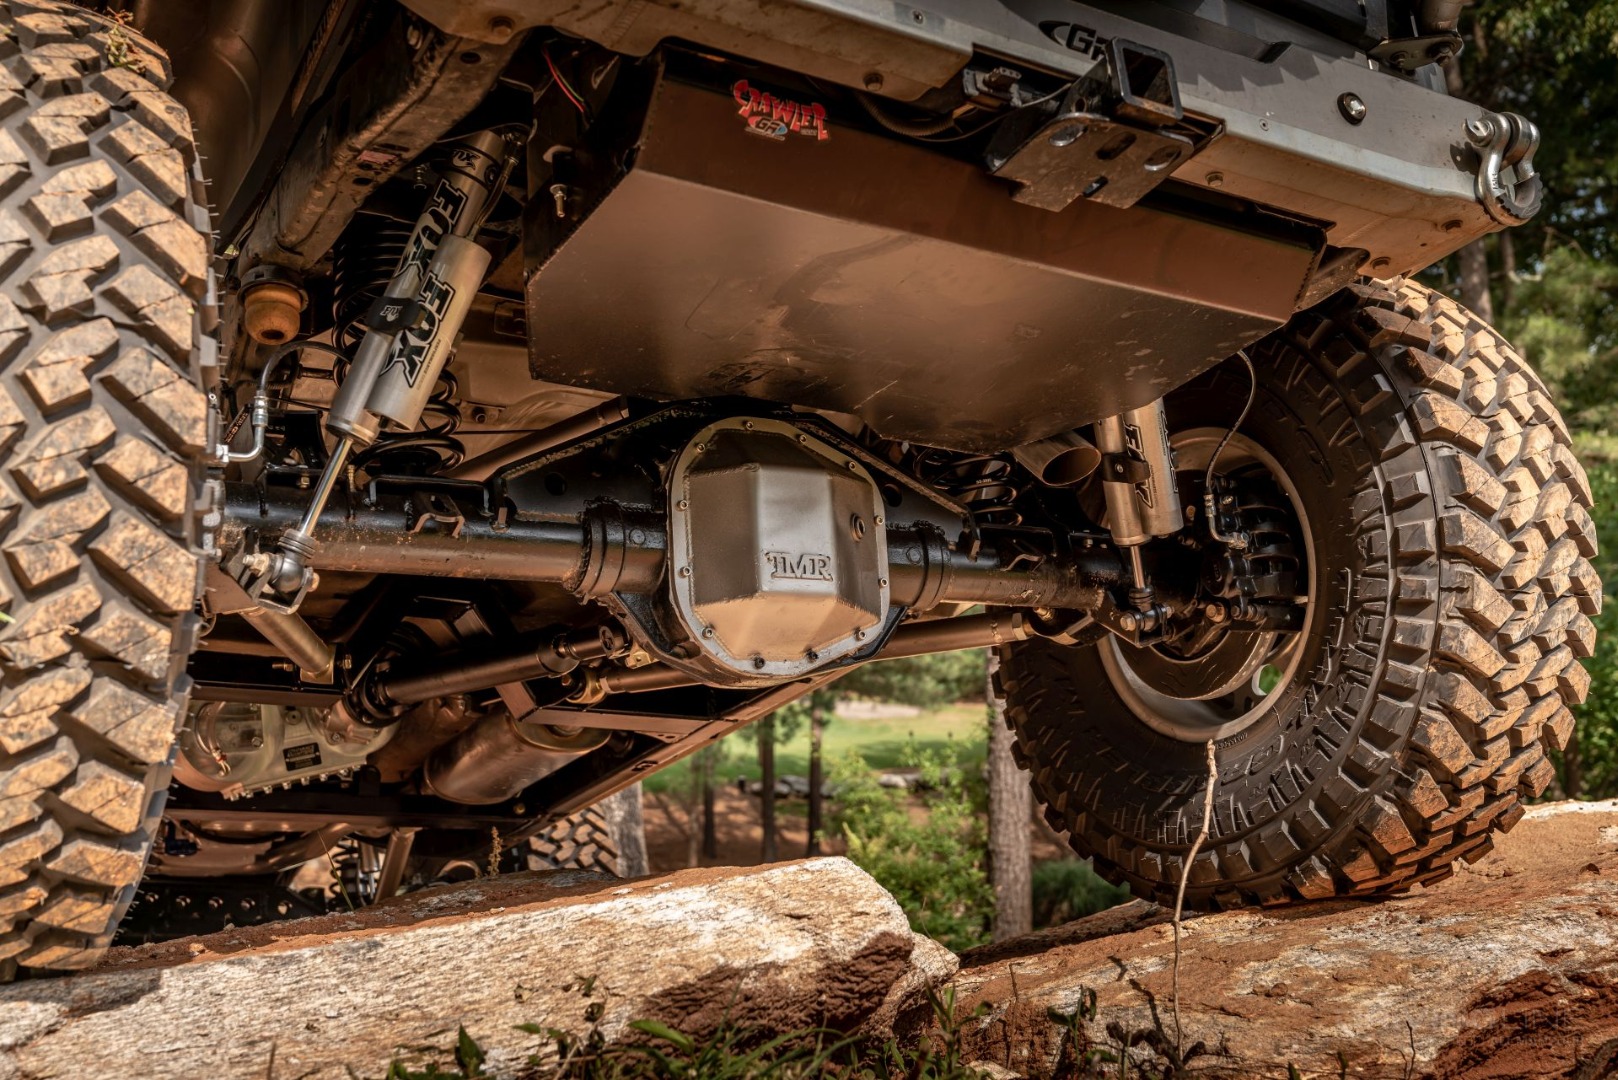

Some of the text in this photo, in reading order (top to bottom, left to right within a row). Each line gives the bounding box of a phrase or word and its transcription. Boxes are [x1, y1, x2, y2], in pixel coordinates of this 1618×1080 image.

[734, 79, 829, 141] CRAWLER
[379, 271, 456, 388] FOX
[380, 304, 402, 319] FOX
